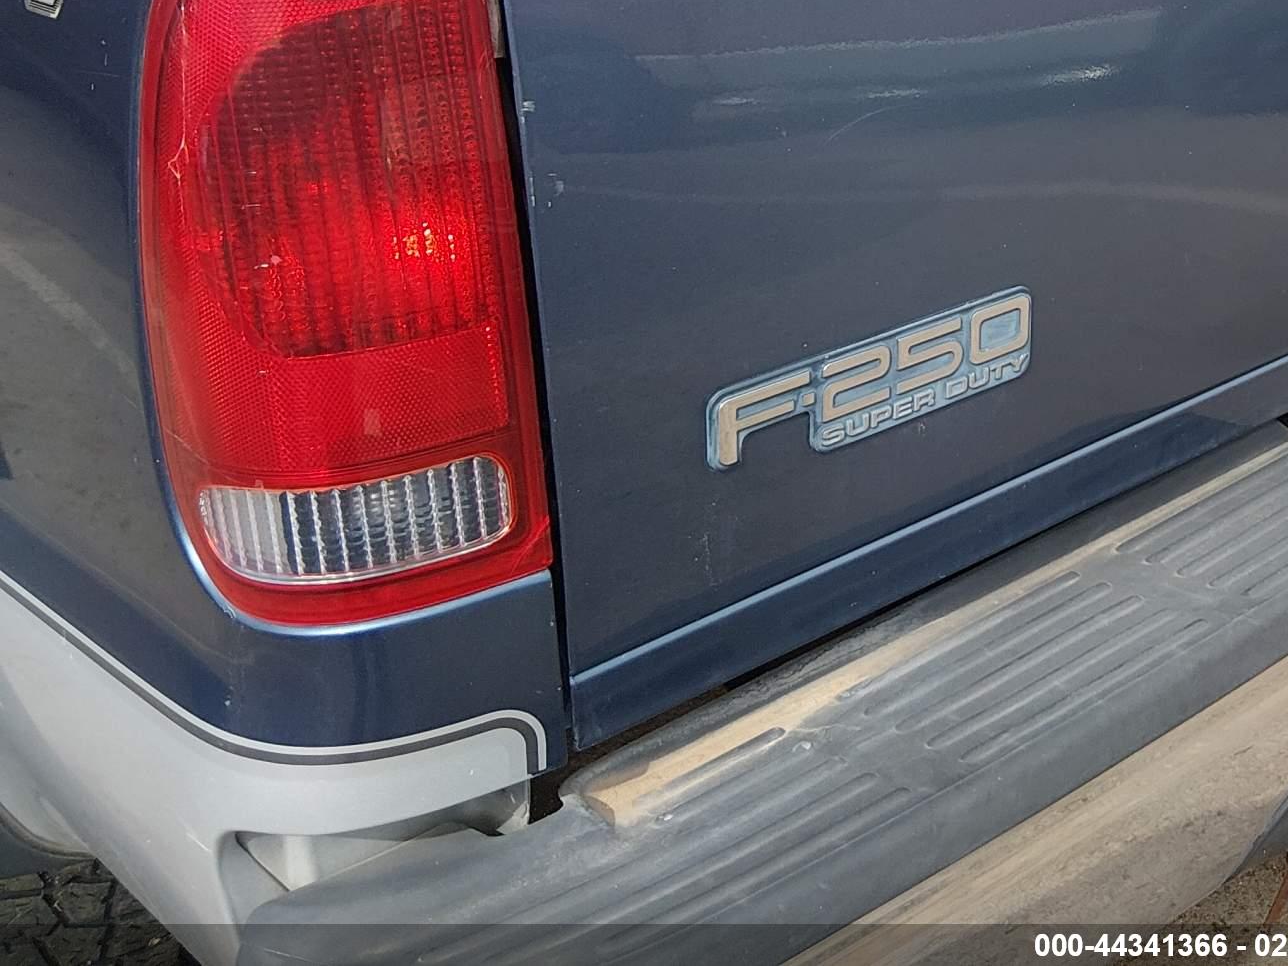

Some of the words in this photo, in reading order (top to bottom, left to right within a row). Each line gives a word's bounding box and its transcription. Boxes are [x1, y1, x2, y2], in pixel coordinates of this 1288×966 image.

[718, 293, 1031, 467] F-250
[821, 388, 936, 448] SUPER
[945, 354, 1029, 400] DUTY
